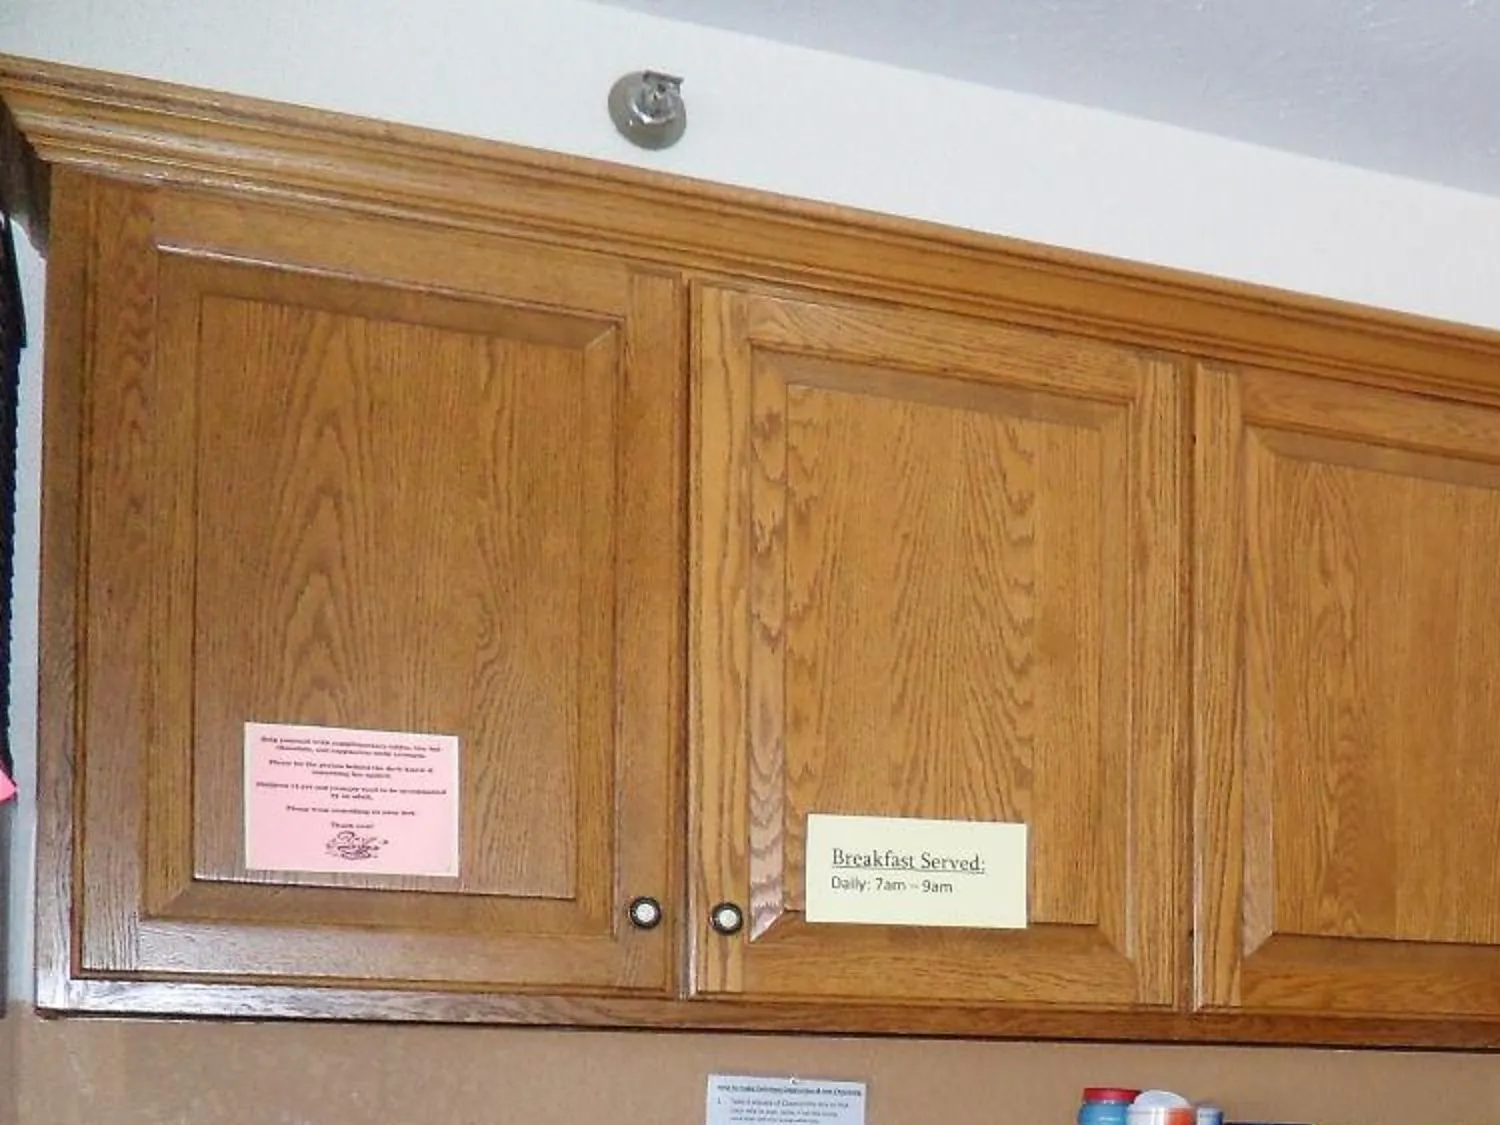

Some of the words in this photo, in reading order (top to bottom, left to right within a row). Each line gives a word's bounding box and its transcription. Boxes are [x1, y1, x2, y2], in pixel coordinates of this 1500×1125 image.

[832, 848, 914, 870] Breakfast
[920, 851, 986, 872] Served:
[831, 876, 871, 892] Daily:
[875, 877, 906, 891] 7am
[921, 879, 953, 893] 9am
